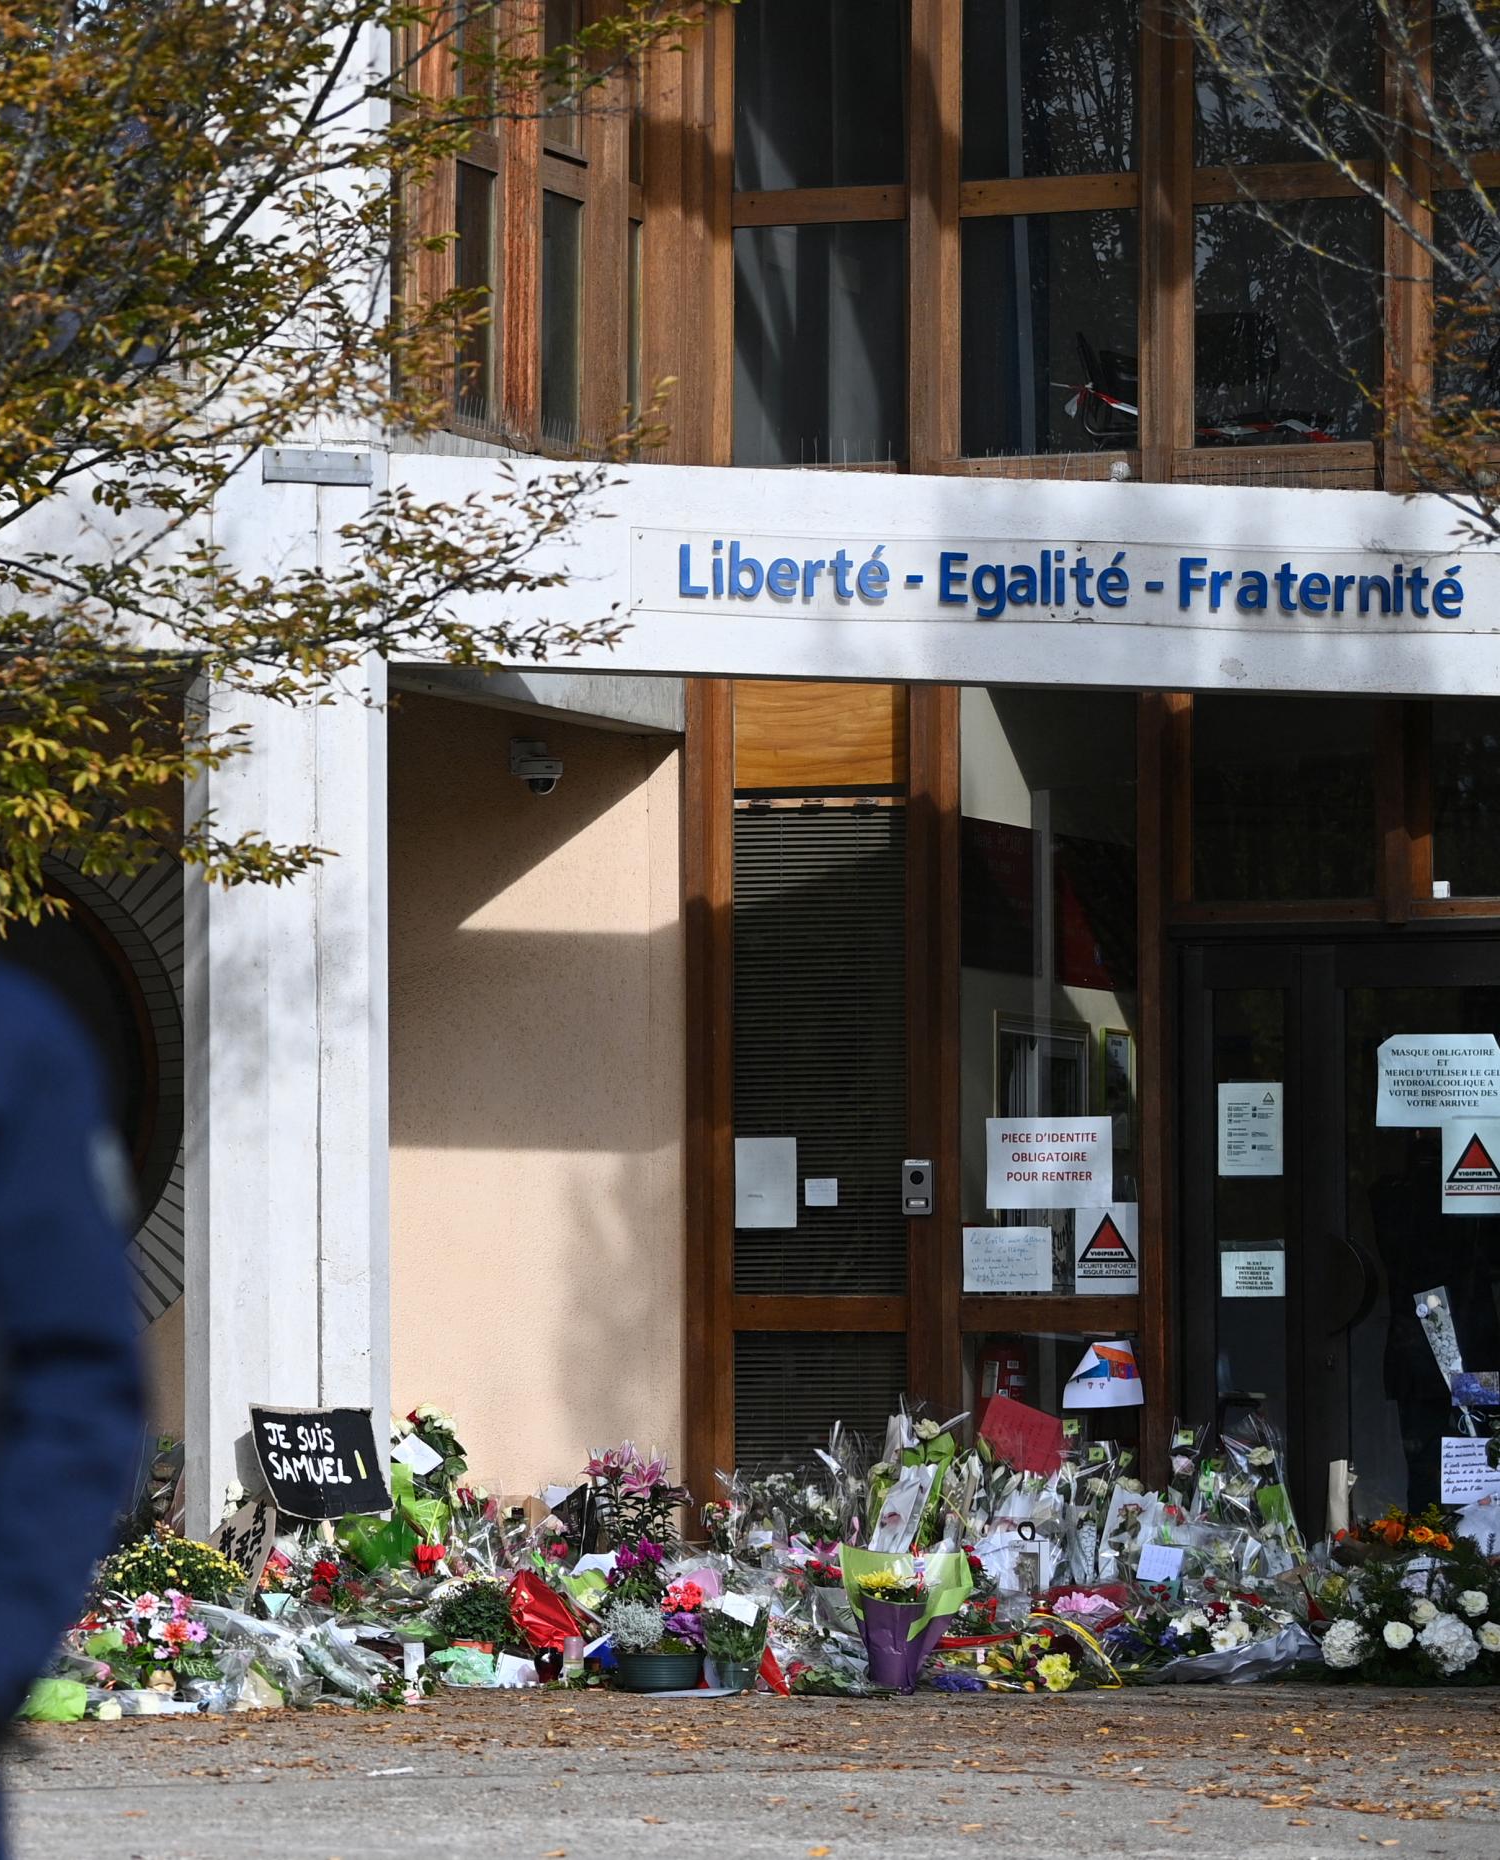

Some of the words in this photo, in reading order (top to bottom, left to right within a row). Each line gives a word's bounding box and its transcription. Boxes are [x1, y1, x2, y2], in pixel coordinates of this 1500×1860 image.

[679, 540, 890, 599] Liberté
[939, 550, 1129, 618] Egalité
[1179, 557, 1464, 618] Fraternité
[1391, 1048, 1430, 1057] MASQUE
[1432, 1048, 1495, 1057] OBLIGATOIRE
[1437, 1059, 1450, 1067] ET
[1385, 1069, 1414, 1077] MERCI
[1416, 1069, 1467, 1077] D'UTILISER
[1470, 1069, 1481, 1077] LE
[1484, 1069, 1500, 1077] GEL
[1393, 1079, 1485, 1088] HYDROALCOOLIQUE
[1389, 1089, 1419, 1097] VOTRE
[1421, 1089, 1478, 1097] DISPOSITION
[1481, 1089, 1498, 1097] DES
[1001, 1133, 1032, 1143] PIECE
[1035, 1132, 1098, 1143] D'IDENTITE
[1012, 1152, 1087, 1162] OBLIGATOIRE
[1006, 1172, 1038, 1182] POUR
[1042, 1171, 1093, 1181] RENTRER
[263, 1422, 292, 1449] JE
[268, 1451, 353, 1485] SAMUEL
